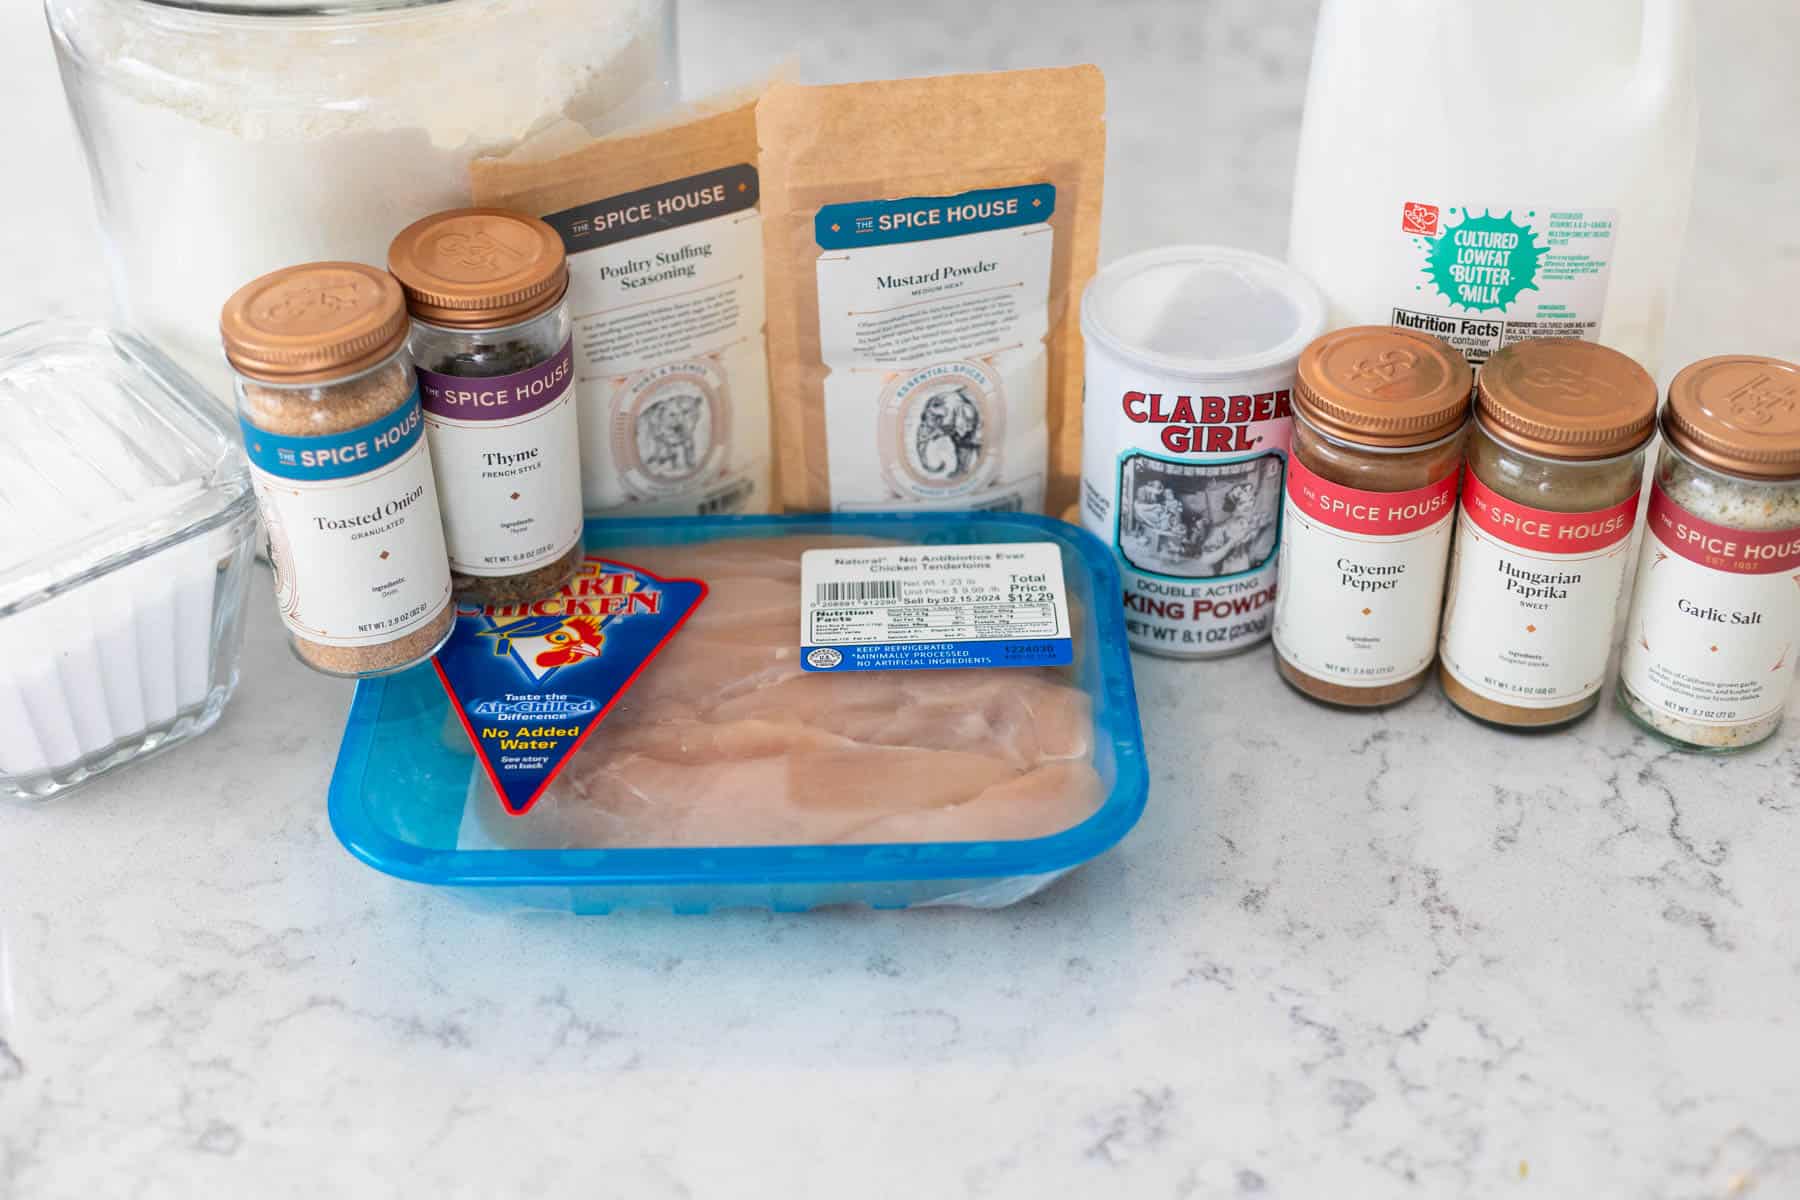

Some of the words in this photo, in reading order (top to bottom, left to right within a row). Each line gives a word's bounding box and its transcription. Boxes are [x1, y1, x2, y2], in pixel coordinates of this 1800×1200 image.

[572, 223, 589, 233] THE
[593, 203, 653, 232] SPICE
[656, 184, 726, 216] HOUSE
[856, 220, 873, 230] THE
[878, 209, 941, 231] SPICE
[947, 198, 1019, 223] HOUSE
[1453, 229, 1519, 249] CULTURED
[600, 260, 652, 281] Poultry
[655, 242, 713, 266] Stuffing
[1457, 249, 1511, 266] LOWFAT
[620, 263, 696, 291] Seasoning
[876, 268, 940, 290] Mustard
[943, 260, 999, 280] Powder
[1449, 264, 1516, 287] BUTTER-
[1457, 284, 1501, 305] MILK
[1395, 311, 1456, 334] Nutrition
[1461, 320, 1500, 337] Facts
[1452, 336, 1491, 347] container
[425, 384, 440, 398] THE
[444, 389, 509, 407] SPICE
[515, 357, 570, 401] HOUSE
[896, 364, 949, 398] ESSENTIAL
[1122, 388, 1293, 424] CLABBER
[301, 441, 369, 468] SPICE
[374, 405, 422, 453] HOUSE
[1160, 425, 1256, 454] GIRL
[482, 447, 539, 467] Thyme
[482, 468, 517, 479] FRENCH
[518, 462, 542, 475] STYLE
[313, 506, 383, 531] Toasted
[385, 484, 424, 516] Onion
[1303, 487, 1316, 501] THE
[1319, 495, 1380, 521] SPICE
[1388, 490, 1449, 521] HOUSE
[351, 517, 406, 541] GRANULATED
[1490, 506, 1551, 538] SPICE
[1557, 513, 1625, 540] HOUSE
[1675, 523, 1737, 557] SPICE
[1744, 538, 1800, 561] HOUS
[870, 564, 918, 574] Chicken
[921, 562, 991, 572] Tenderloins
[899, 555, 918, 564] No
[921, 553, 992, 563] Antibiotics
[995, 552, 1025, 561] Ever
[1336, 557, 1406, 577] Cayenne
[1009, 574, 1046, 584] Total
[1498, 559, 1582, 586] Hungarian
[560, 573, 636, 597] ART
[1010, 583, 1048, 593] Price
[1136, 578, 1201, 598] DOUBLE
[1205, 577, 1260, 597] ACTING
[1341, 574, 1398, 593] Pepper
[1506, 578, 1568, 600] Paprika
[903, 596, 924, 605] Sell
[1007, 592, 1055, 603] $12.29
[1122, 588, 1185, 621] KING
[1519, 600, 1549, 611] SWEET
[1677, 598, 1728, 624] Garlic
[1730, 611, 1764, 625] Salt
[358, 620, 373, 633] NET
[1126, 619, 1150, 636] ET
[1152, 624, 1179, 642] WT
[1206, 625, 1227, 643] OZ
[883, 644, 954, 653] REFRIGERATED
[914, 650, 970, 659] PROCESSED
[874, 658, 926, 667] ARTIFICIAL
[928, 656, 993, 666] INGREDIENTS
[474, 699, 596, 714] Air-Chilled
[505, 693, 541, 702] Taste
[544, 693, 568, 701] the
[497, 713, 568, 721] Difference
[482, 728, 509, 739] No
[516, 726, 580, 738] Added
[500, 739, 558, 750] Water
[501, 755, 521, 763] See
[522, 756, 549, 764] story
[519, 761, 544, 769] back
